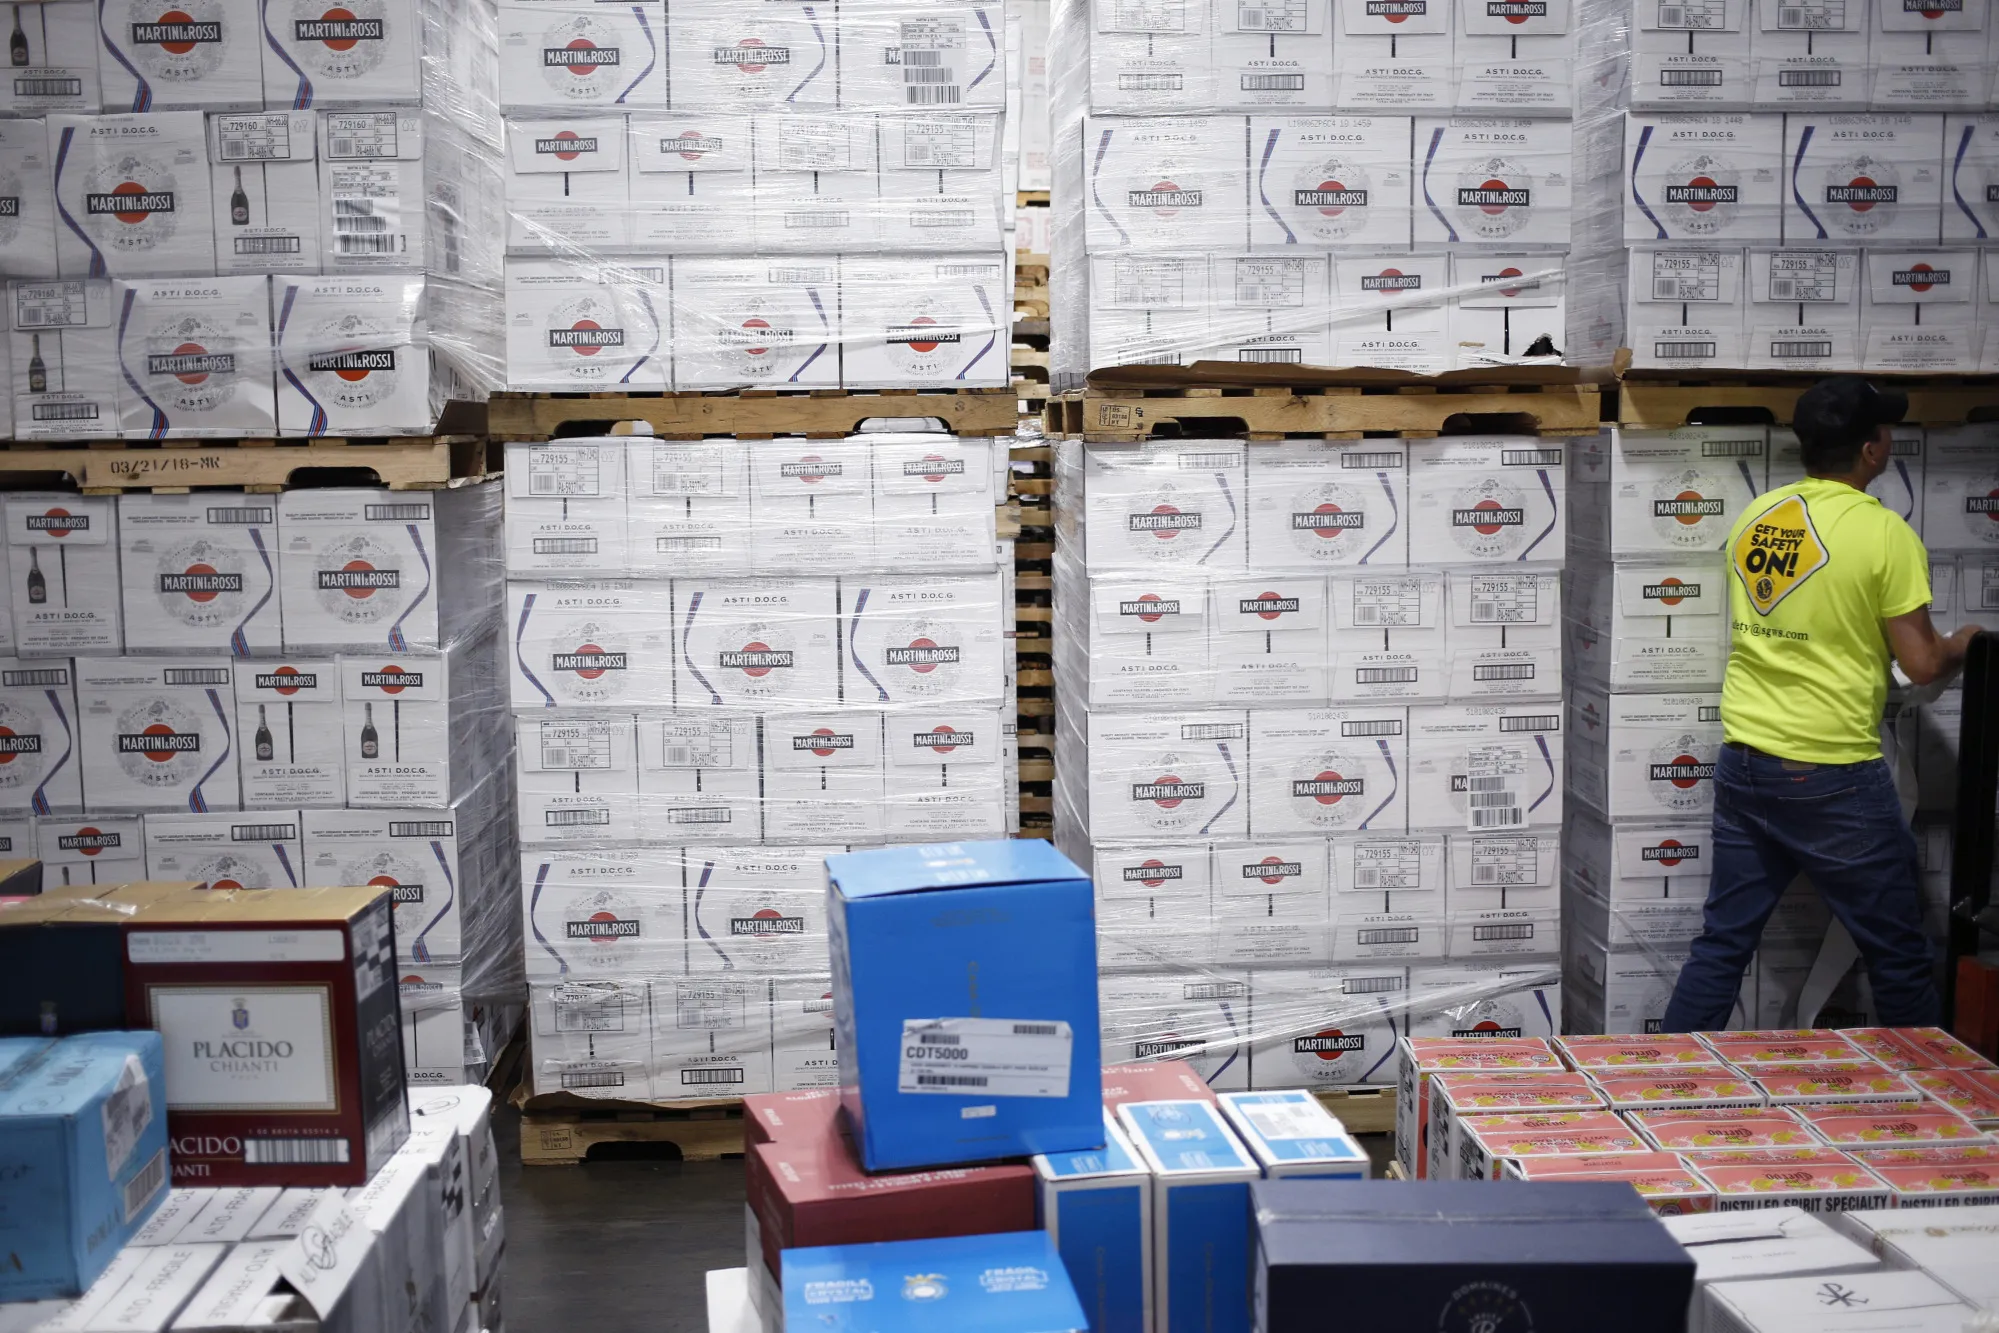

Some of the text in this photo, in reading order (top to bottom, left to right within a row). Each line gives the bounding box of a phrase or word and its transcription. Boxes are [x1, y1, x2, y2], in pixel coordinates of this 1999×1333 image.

[230, 121, 257, 131] 729160
[339, 119, 366, 129] 729160
[1664, 259, 1690, 269] 729155
[1781, 259, 1807, 269] 729155
[1248, 265, 1274, 275] 729155
[541, 453, 568, 463] 729155
[1755, 524, 1805, 538] GET YOUR
[1751, 534, 1802, 551] SAFETY
[1746, 548, 1799, 577] ON!
[1365, 585, 1391, 595] 729155
[1482, 582, 1508, 591] 729155
[552, 728, 579, 739] 729155
[674, 727, 701, 736] 729155
[1365, 849, 1390, 859] 729155
[1483, 844, 1509, 856] 729155
[194, 1041, 293, 1059] PLACIDO
[906, 1047, 969, 1060] CDT5000
[210, 1061, 279, 1072] CHIANTI
[169, 1137, 240, 1154] ACIDO
[1826, 1196, 1887, 1212] SPECIALTY
